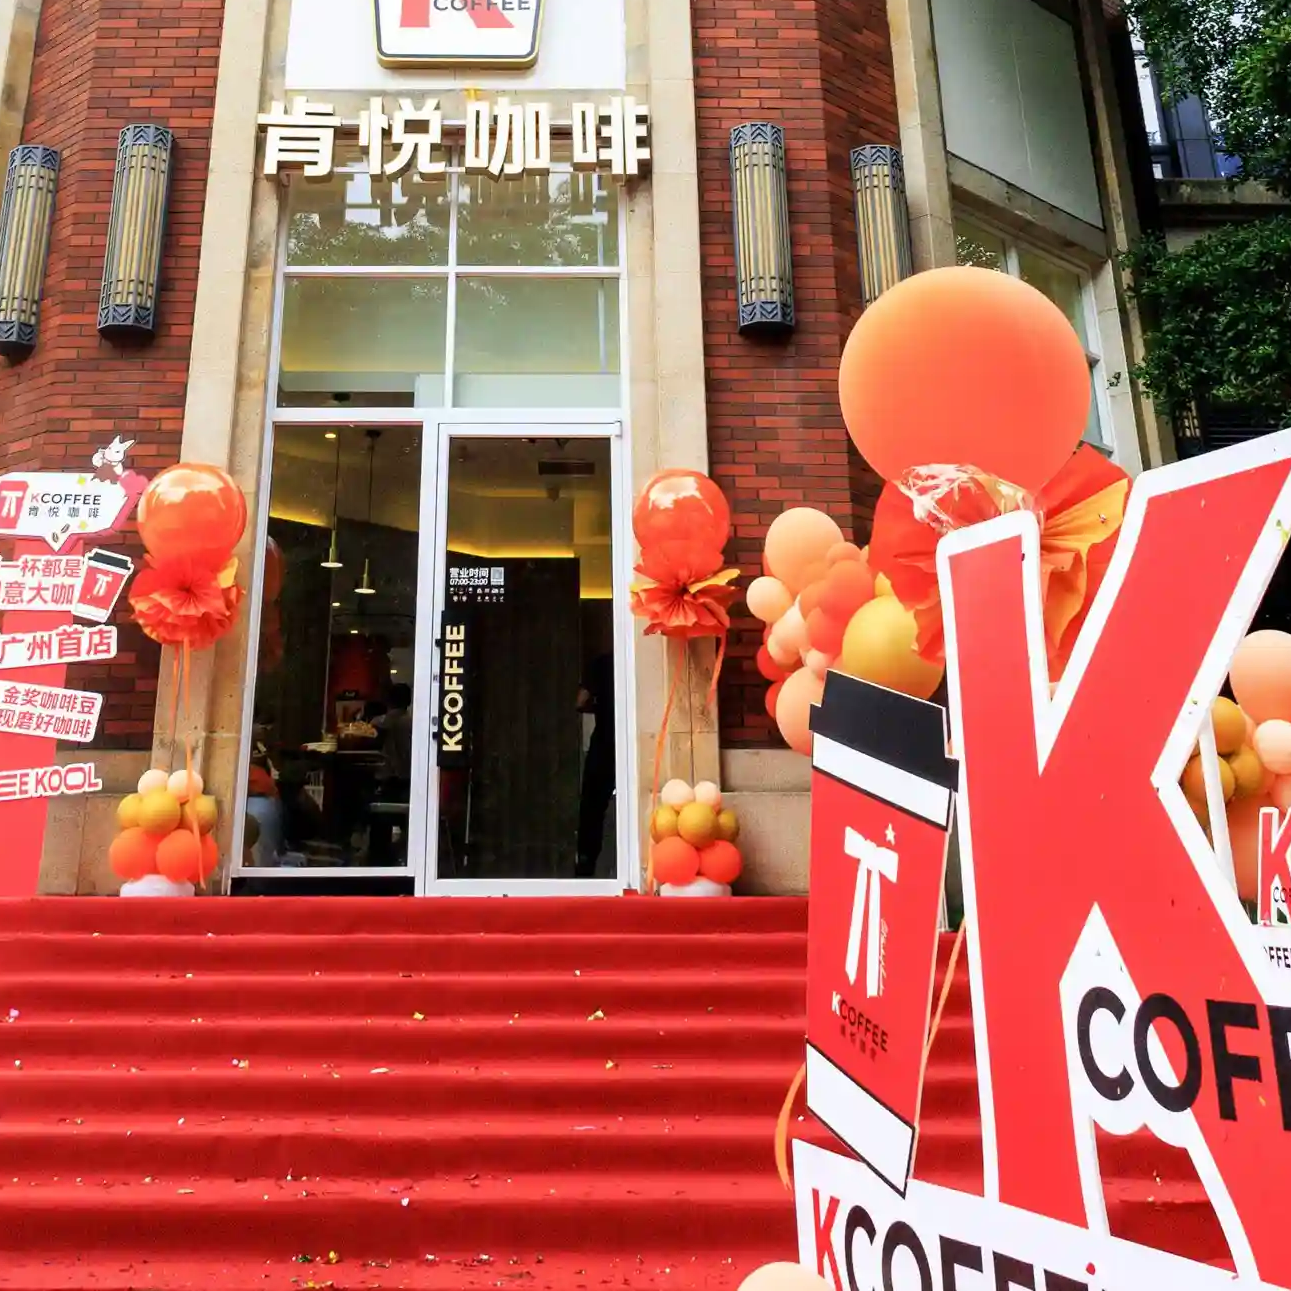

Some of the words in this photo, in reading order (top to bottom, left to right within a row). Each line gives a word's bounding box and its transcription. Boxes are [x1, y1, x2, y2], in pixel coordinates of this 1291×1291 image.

[257, 96, 651, 185] 肯悦咖啡
[28, 506, 100, 519] 肯悦咖啡
[30, 493, 102, 506] KCOFFEE
[1, 685, 98, 716] 金奖咖啡豆
[442, 624, 466, 751] KCOFFEE
[34, 765, 100, 794] KOOL
[831, 991, 889, 1053] KCOFFEE
